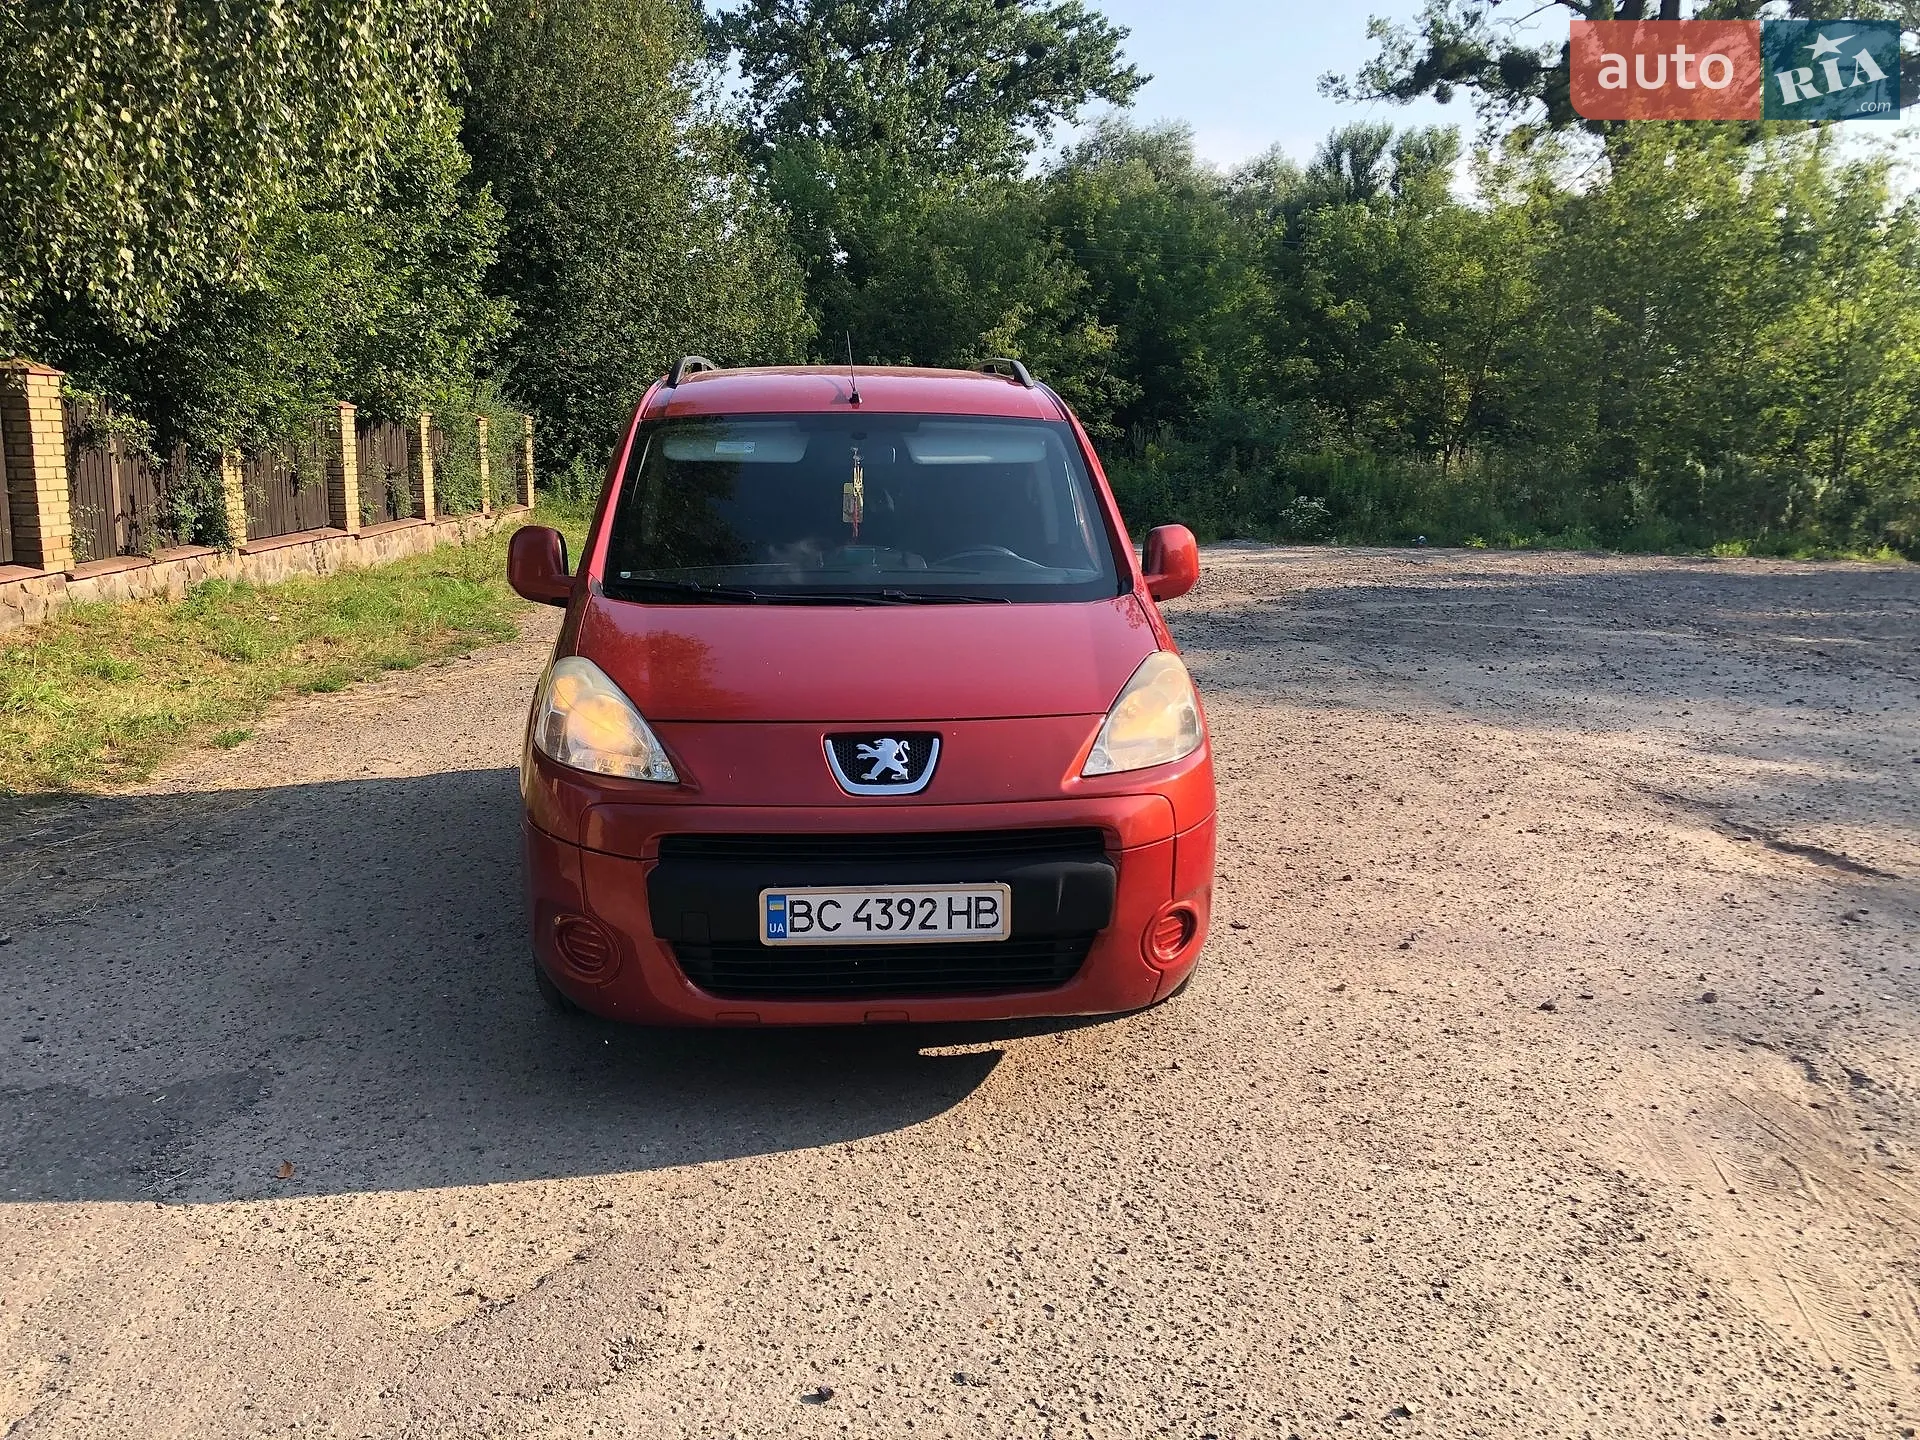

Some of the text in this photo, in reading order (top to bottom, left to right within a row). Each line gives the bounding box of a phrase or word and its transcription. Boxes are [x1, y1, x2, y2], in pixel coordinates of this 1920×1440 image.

[789, 896, 1000, 932] BC 4392 HB
[769, 922, 785, 933] UA
